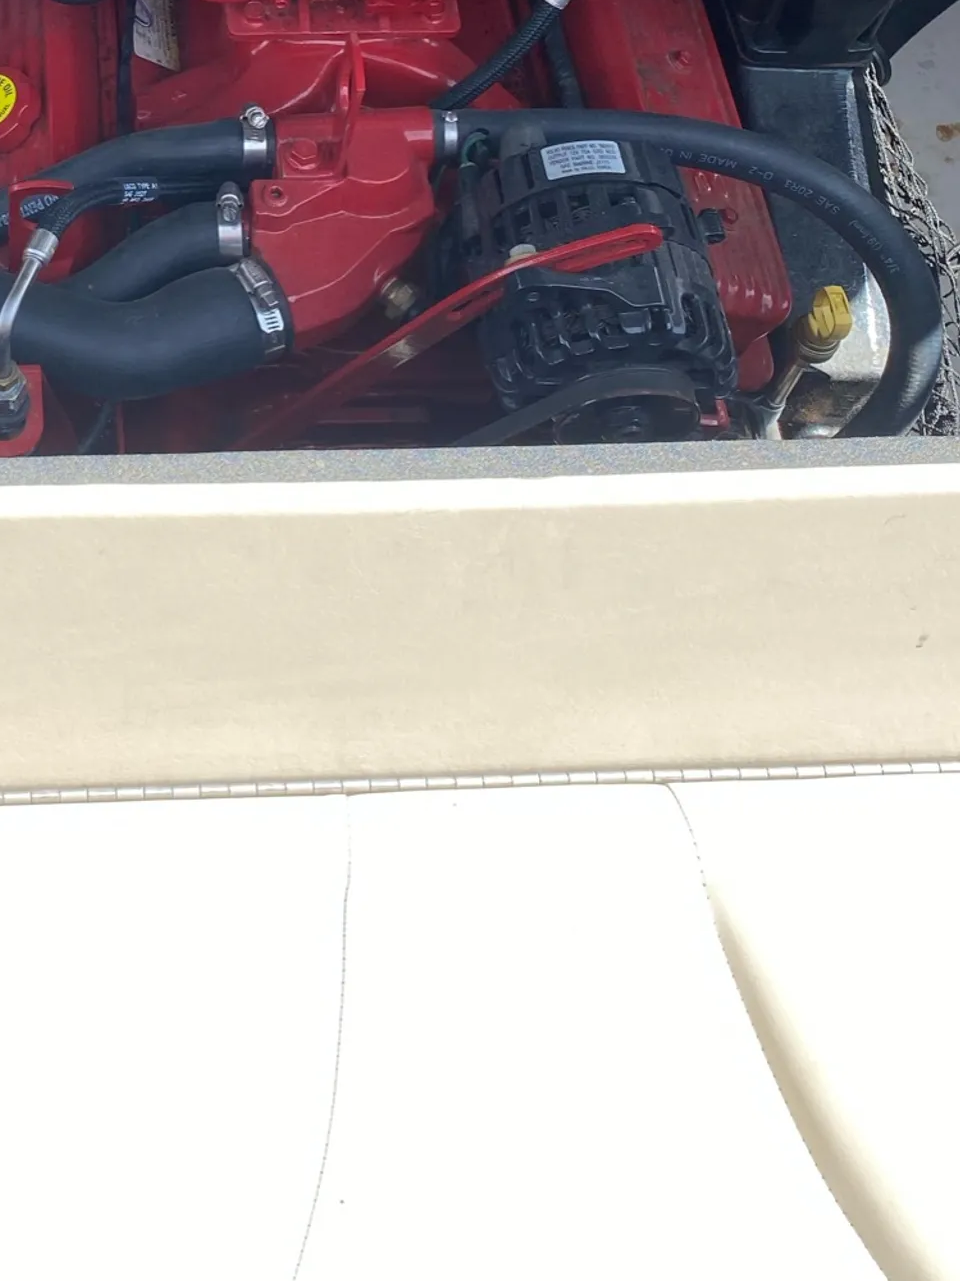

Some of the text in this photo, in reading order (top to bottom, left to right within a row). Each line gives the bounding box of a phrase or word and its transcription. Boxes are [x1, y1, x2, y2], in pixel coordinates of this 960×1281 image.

[3, 83, 14, 98] OIL
[679, 151, 692, 160] IN
[698, 153, 737, 169] MADE
[783, 179, 814, 198] 20R3
[816, 195, 841, 215] SAE
